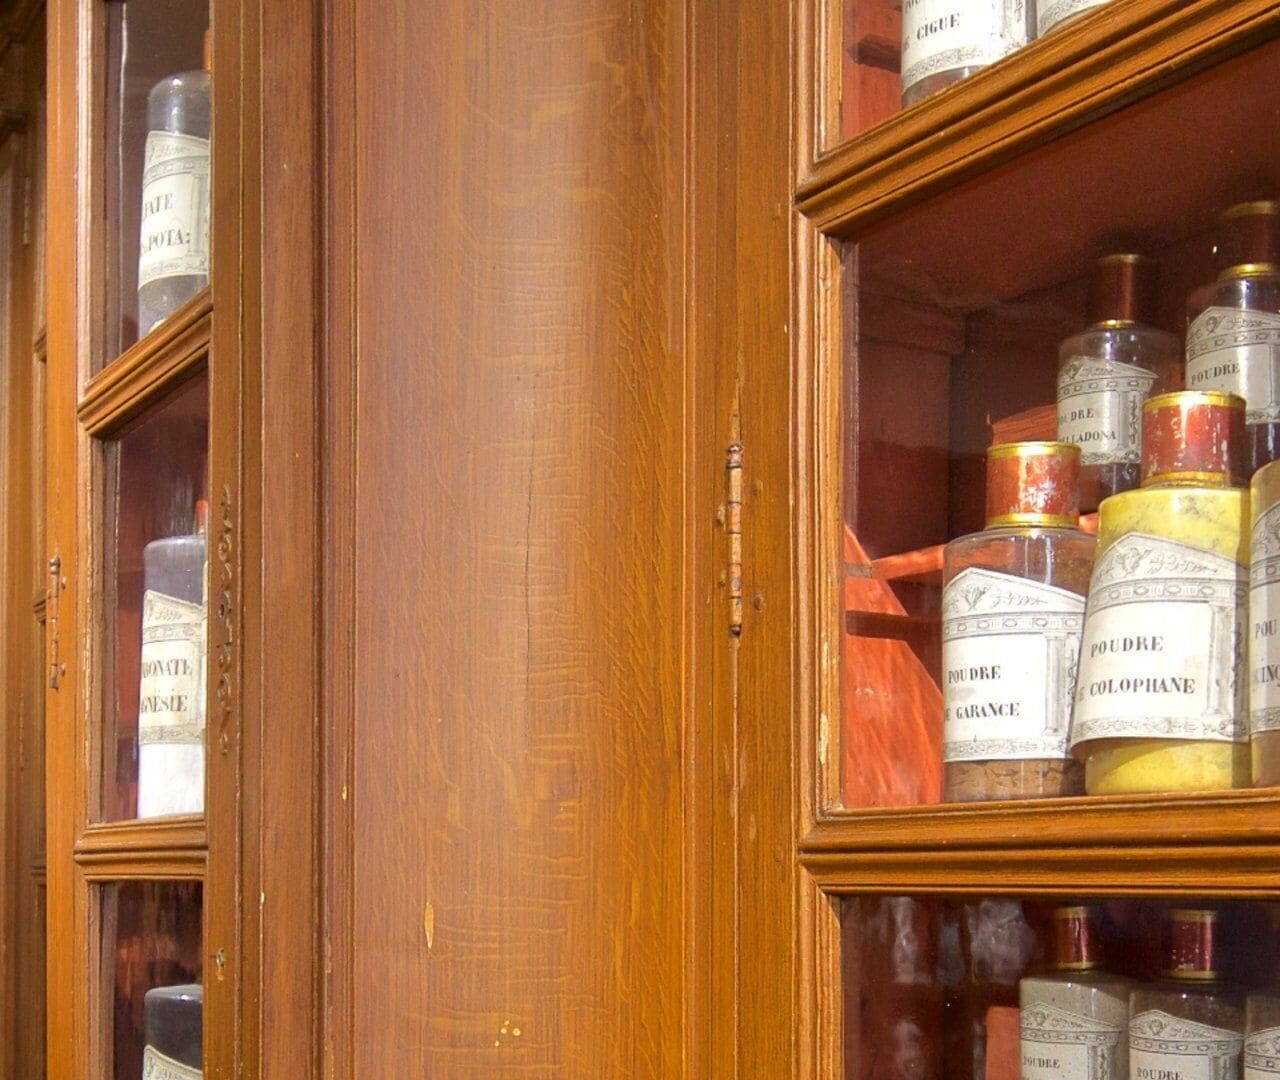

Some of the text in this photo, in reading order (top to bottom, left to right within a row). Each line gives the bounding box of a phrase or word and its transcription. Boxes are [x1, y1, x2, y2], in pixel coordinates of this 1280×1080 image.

[1191, 363, 1241, 386] POUDRE
[1091, 636, 1164, 658] POUDRE
[948, 665, 1001, 684] POUDRE
[1090, 676, 1196, 697] COLOPHANE
[956, 702, 1020, 720] GARANCE
[1023, 1055, 1060, 1070] POUDRE
